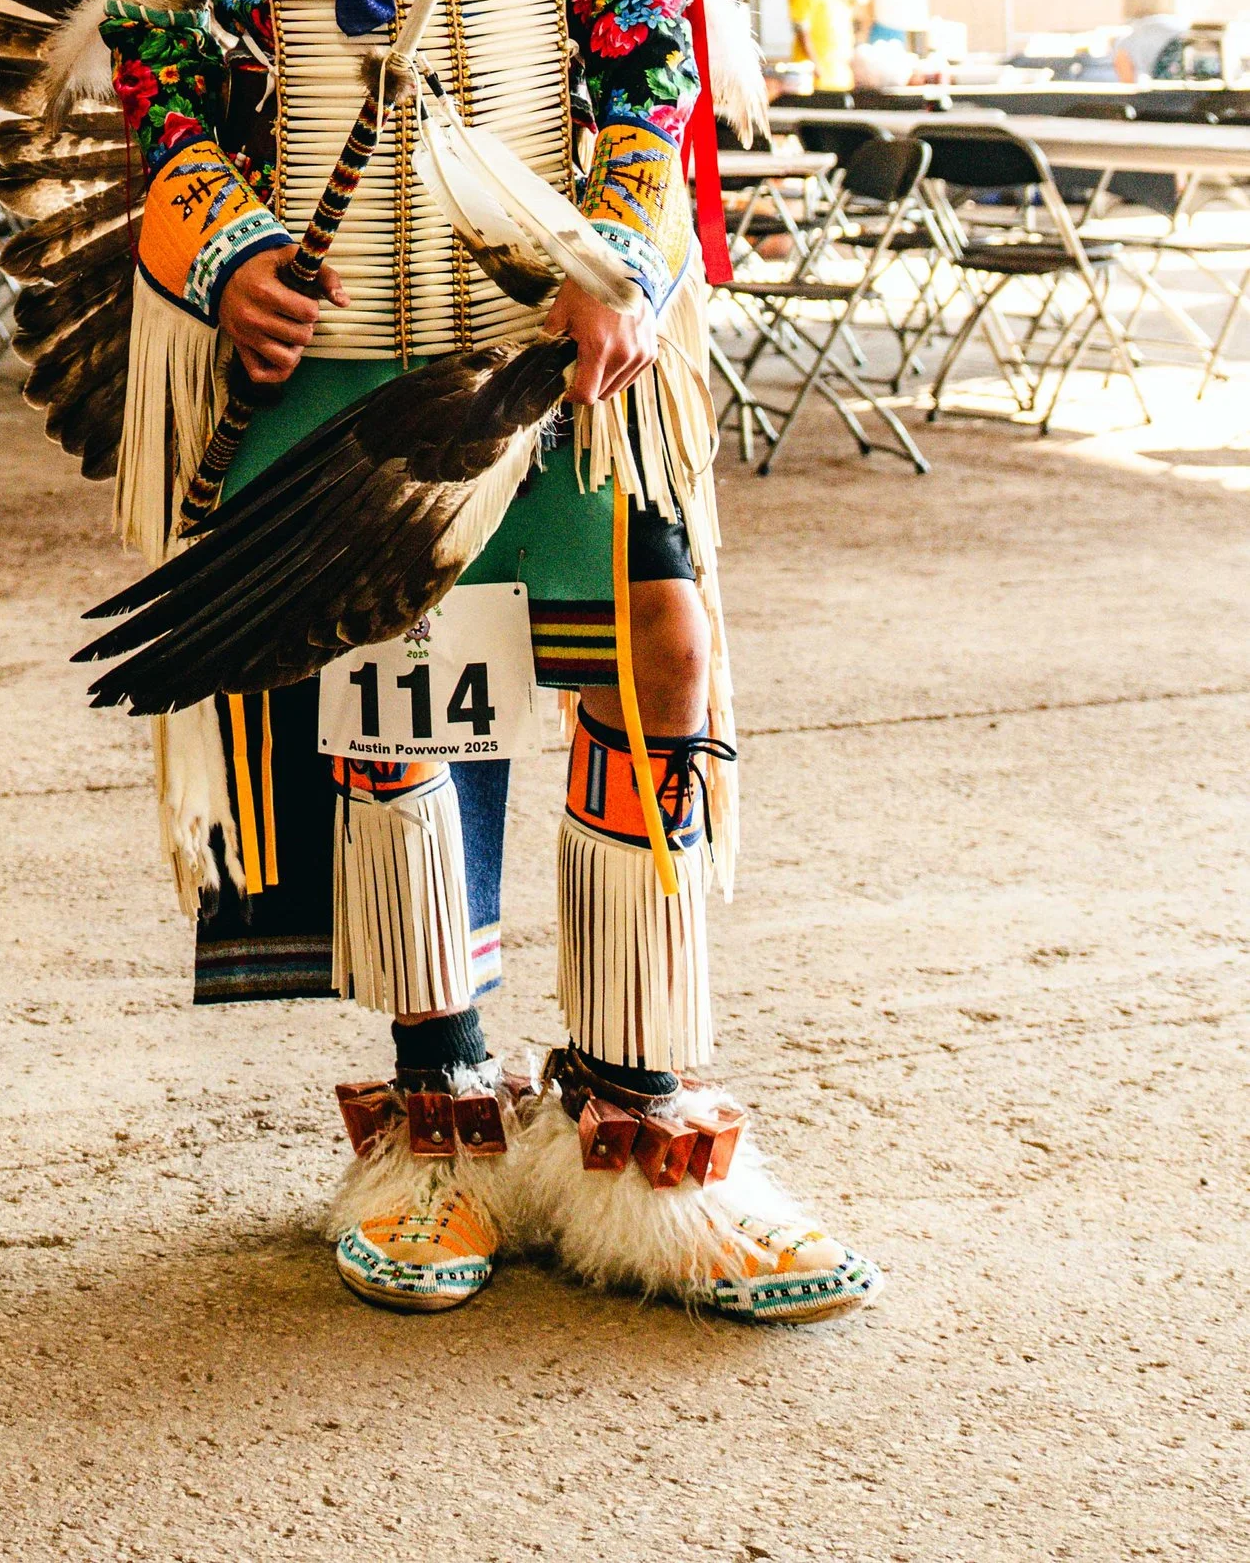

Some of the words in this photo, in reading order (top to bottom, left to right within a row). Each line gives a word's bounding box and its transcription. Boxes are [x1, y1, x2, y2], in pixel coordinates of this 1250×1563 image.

[407, 650, 429, 659] 2025
[350, 661, 495, 738] 114
[349, 740, 391, 754] Austin
[395, 744, 460, 755] Powwow
[465, 741, 498, 753] 2025
